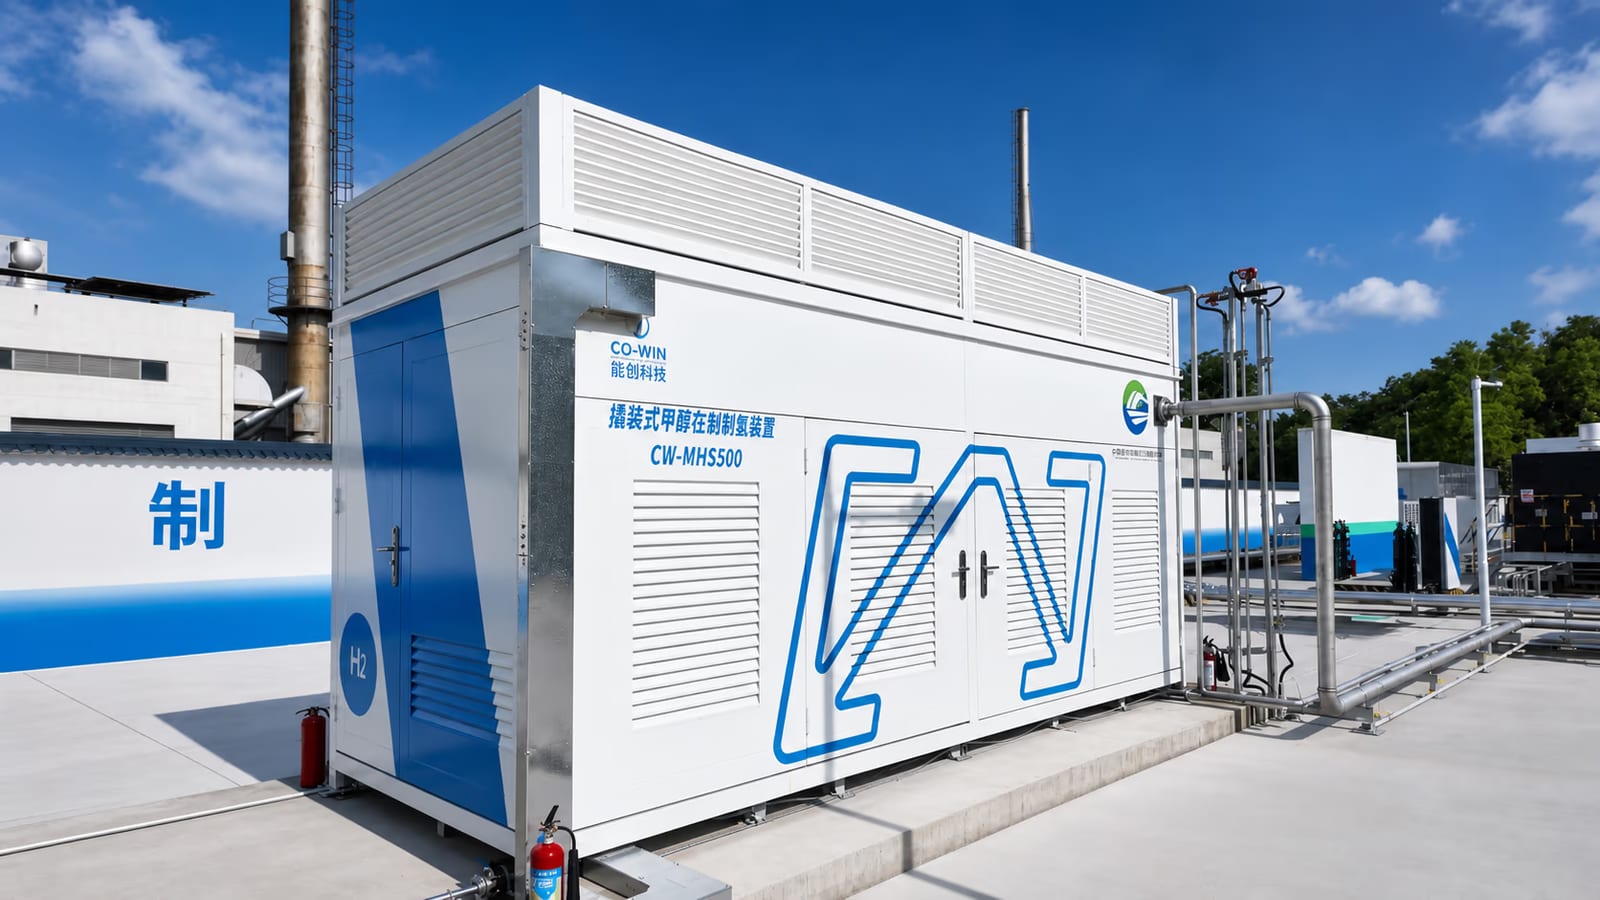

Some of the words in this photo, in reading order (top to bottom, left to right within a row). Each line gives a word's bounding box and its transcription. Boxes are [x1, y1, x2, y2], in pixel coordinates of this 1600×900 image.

[610, 340, 667, 361] CO-WIN
[610, 361, 667, 383] 能创科技
[650, 444, 743, 468] CW-MHS500
[149, 479, 226, 551] 制
[350, 645, 368, 680] H2
